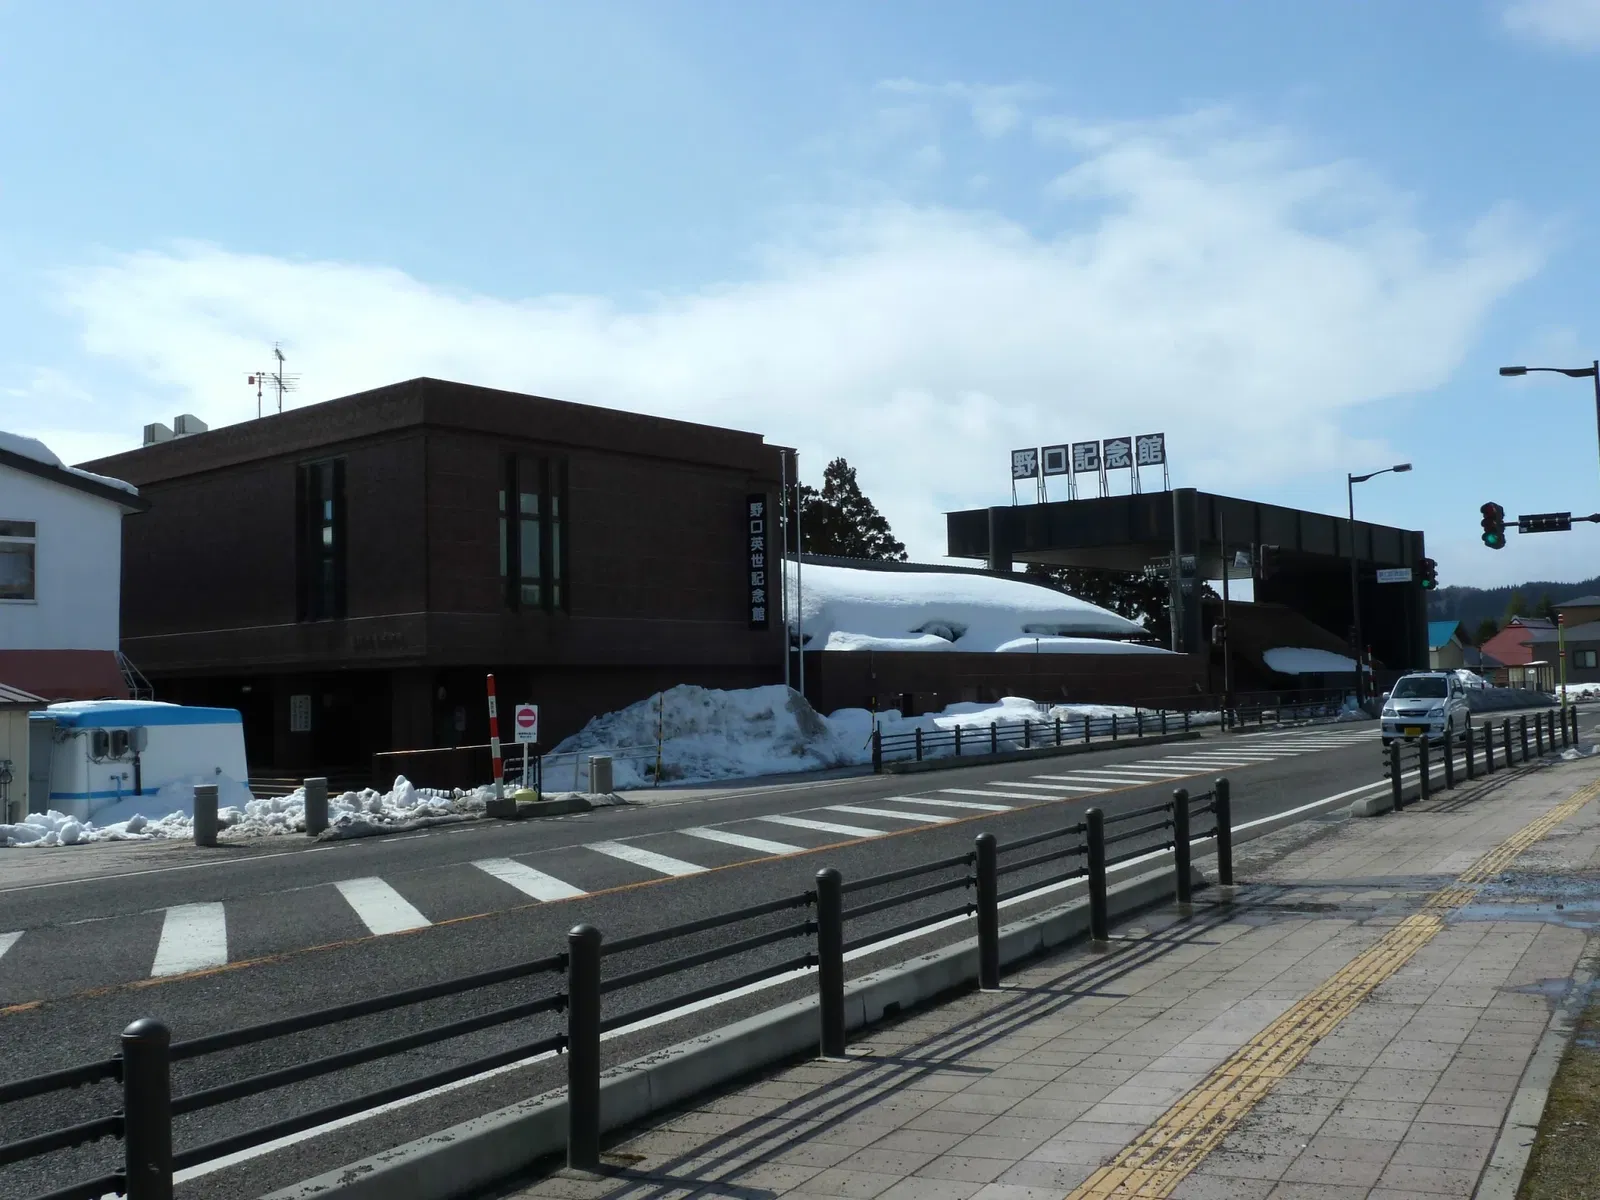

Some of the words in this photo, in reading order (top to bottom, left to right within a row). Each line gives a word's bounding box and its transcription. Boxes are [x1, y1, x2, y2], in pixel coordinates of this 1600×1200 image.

[1013, 435, 1163, 478] 野口記念館
[749, 502, 766, 622] 野口英世記念館
